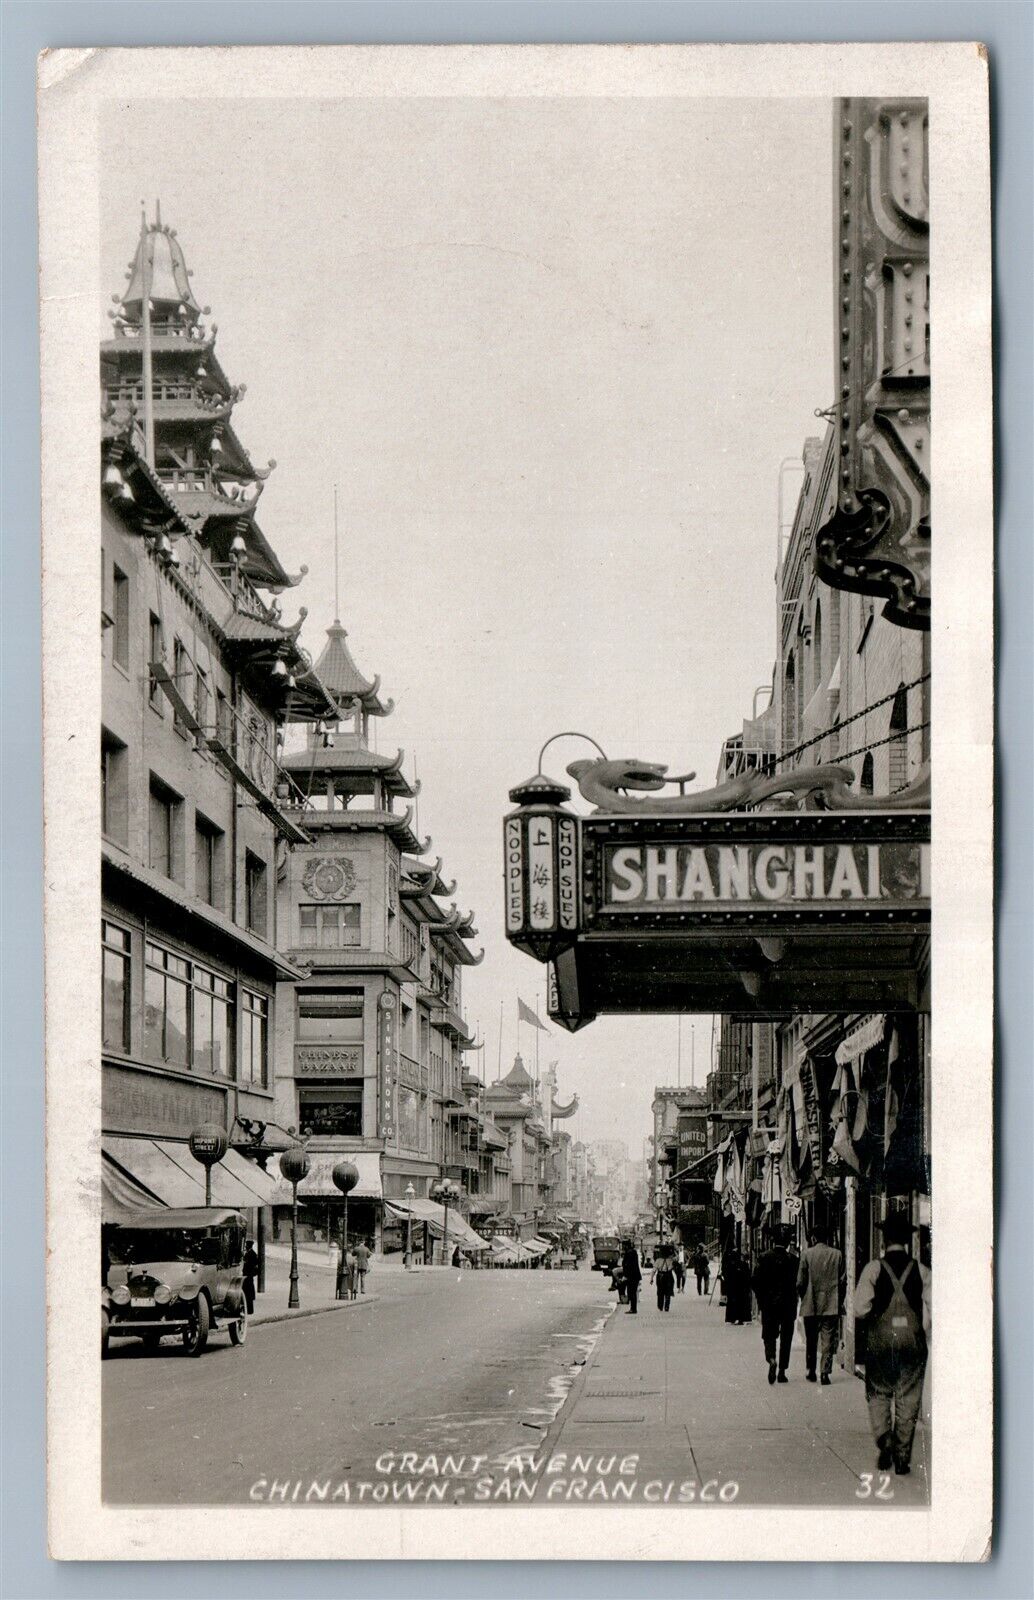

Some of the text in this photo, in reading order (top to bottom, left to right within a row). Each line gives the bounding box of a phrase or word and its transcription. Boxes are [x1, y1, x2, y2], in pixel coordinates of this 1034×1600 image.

[509, 824, 521, 923] NOODLES
[560, 819, 573, 927] CHOP SUEY
[610, 844, 882, 903] SHANGHAI
[298, 1050, 359, 1061] CHINESE
[301, 1061, 358, 1073] BAZAAR
[680, 1131, 706, 1143] UNITED
[681, 1146, 706, 1156] IMPORT
